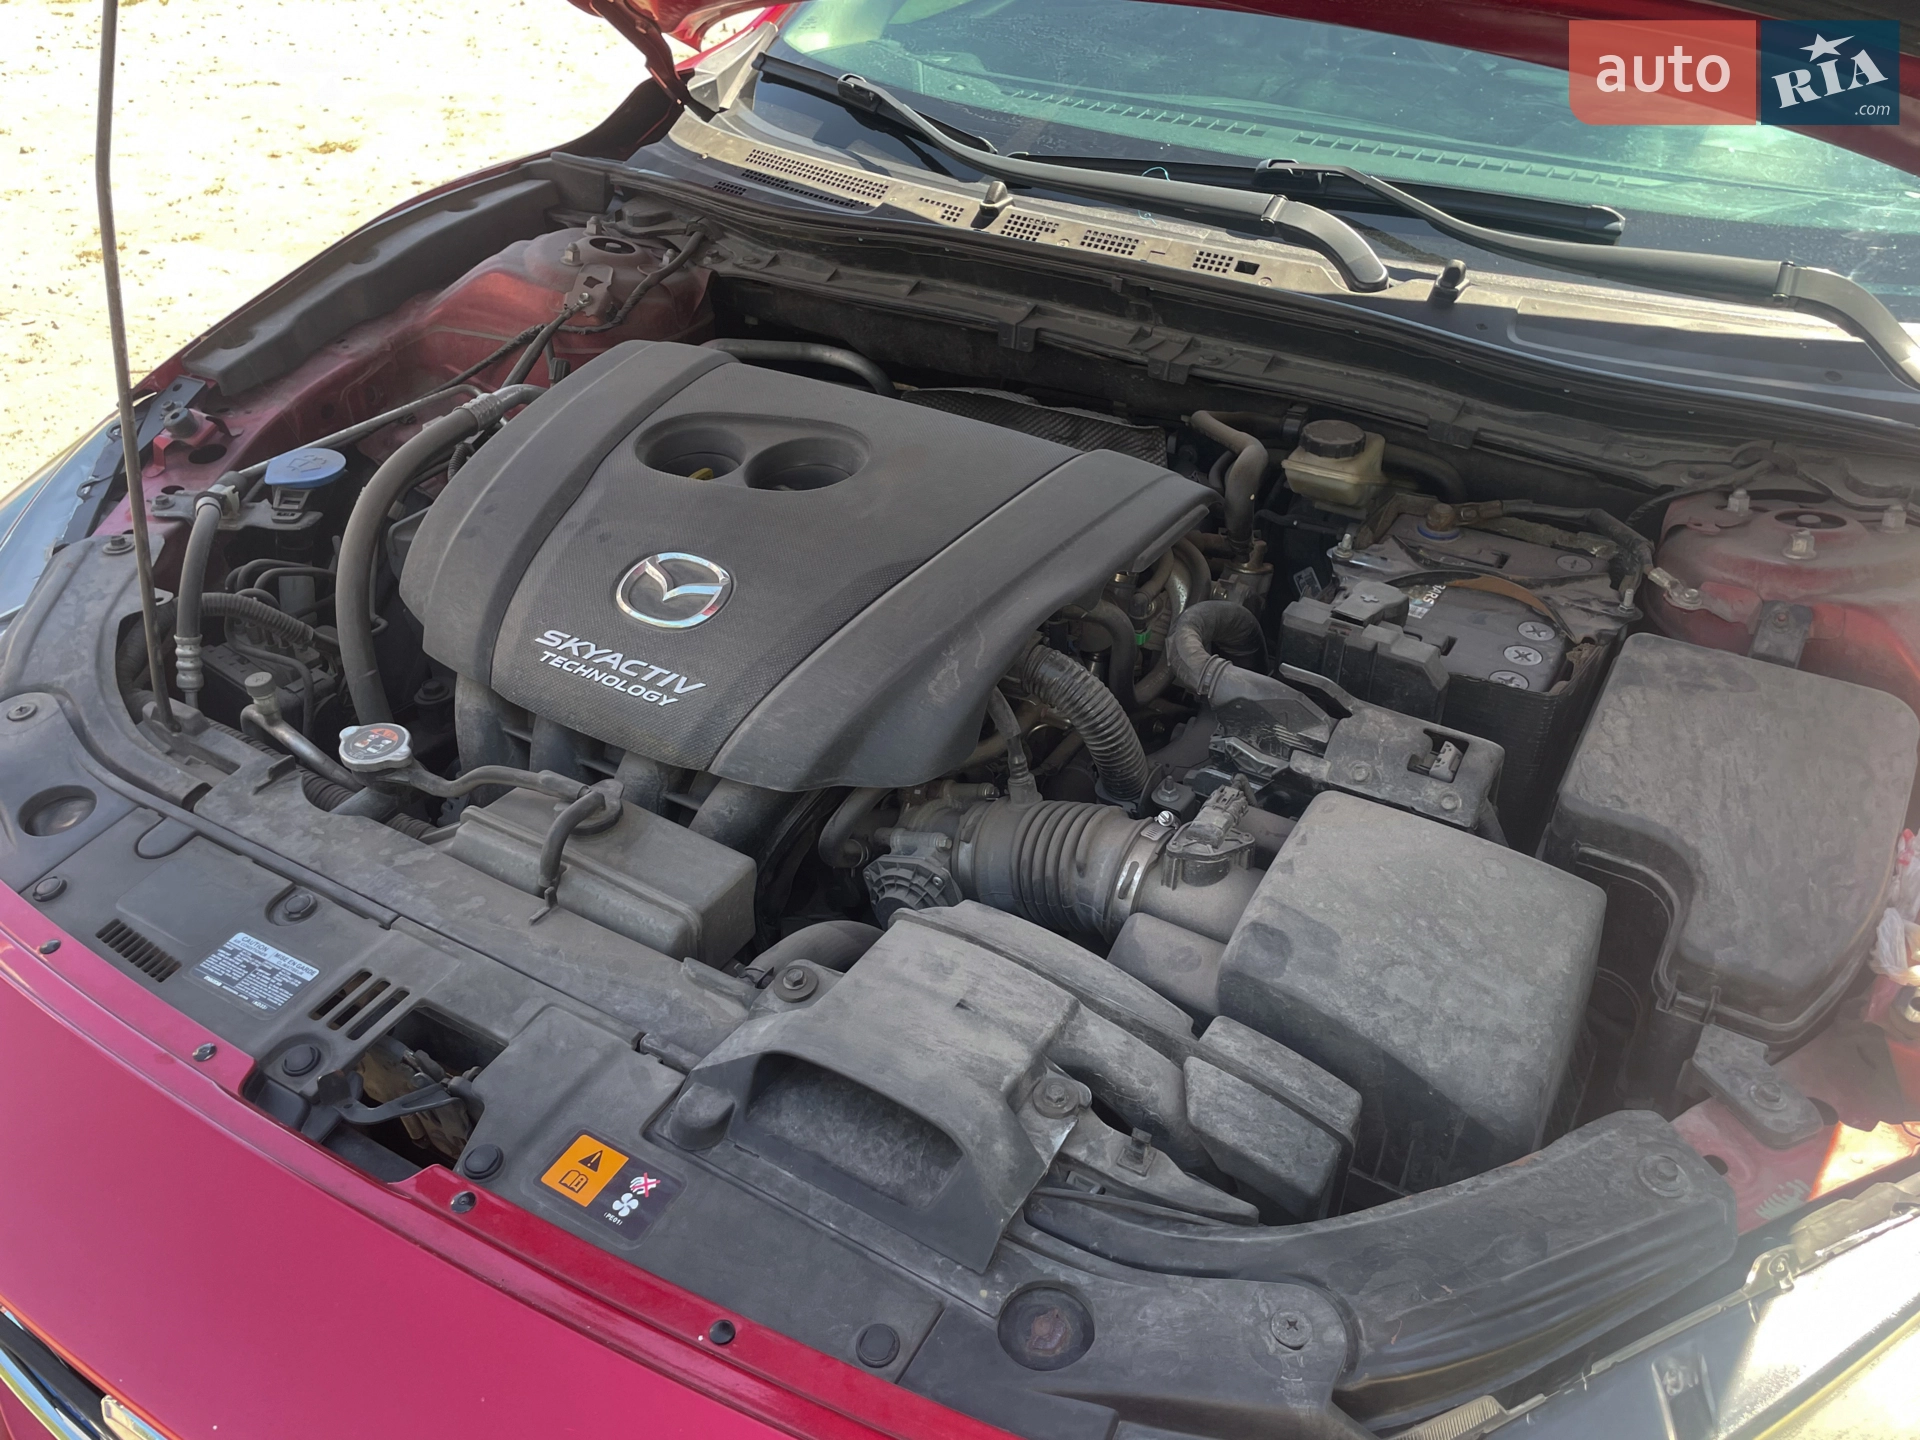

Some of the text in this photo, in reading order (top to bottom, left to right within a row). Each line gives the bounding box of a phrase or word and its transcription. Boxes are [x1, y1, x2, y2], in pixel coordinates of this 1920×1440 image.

[535, 629, 707, 695] SKYACTIV
[539, 650, 679, 707] TECHNOLOGY
[241, 936, 269, 953] CAUTION
[274, 952, 288, 963] MISE
[295, 962, 317, 977] GARDE
